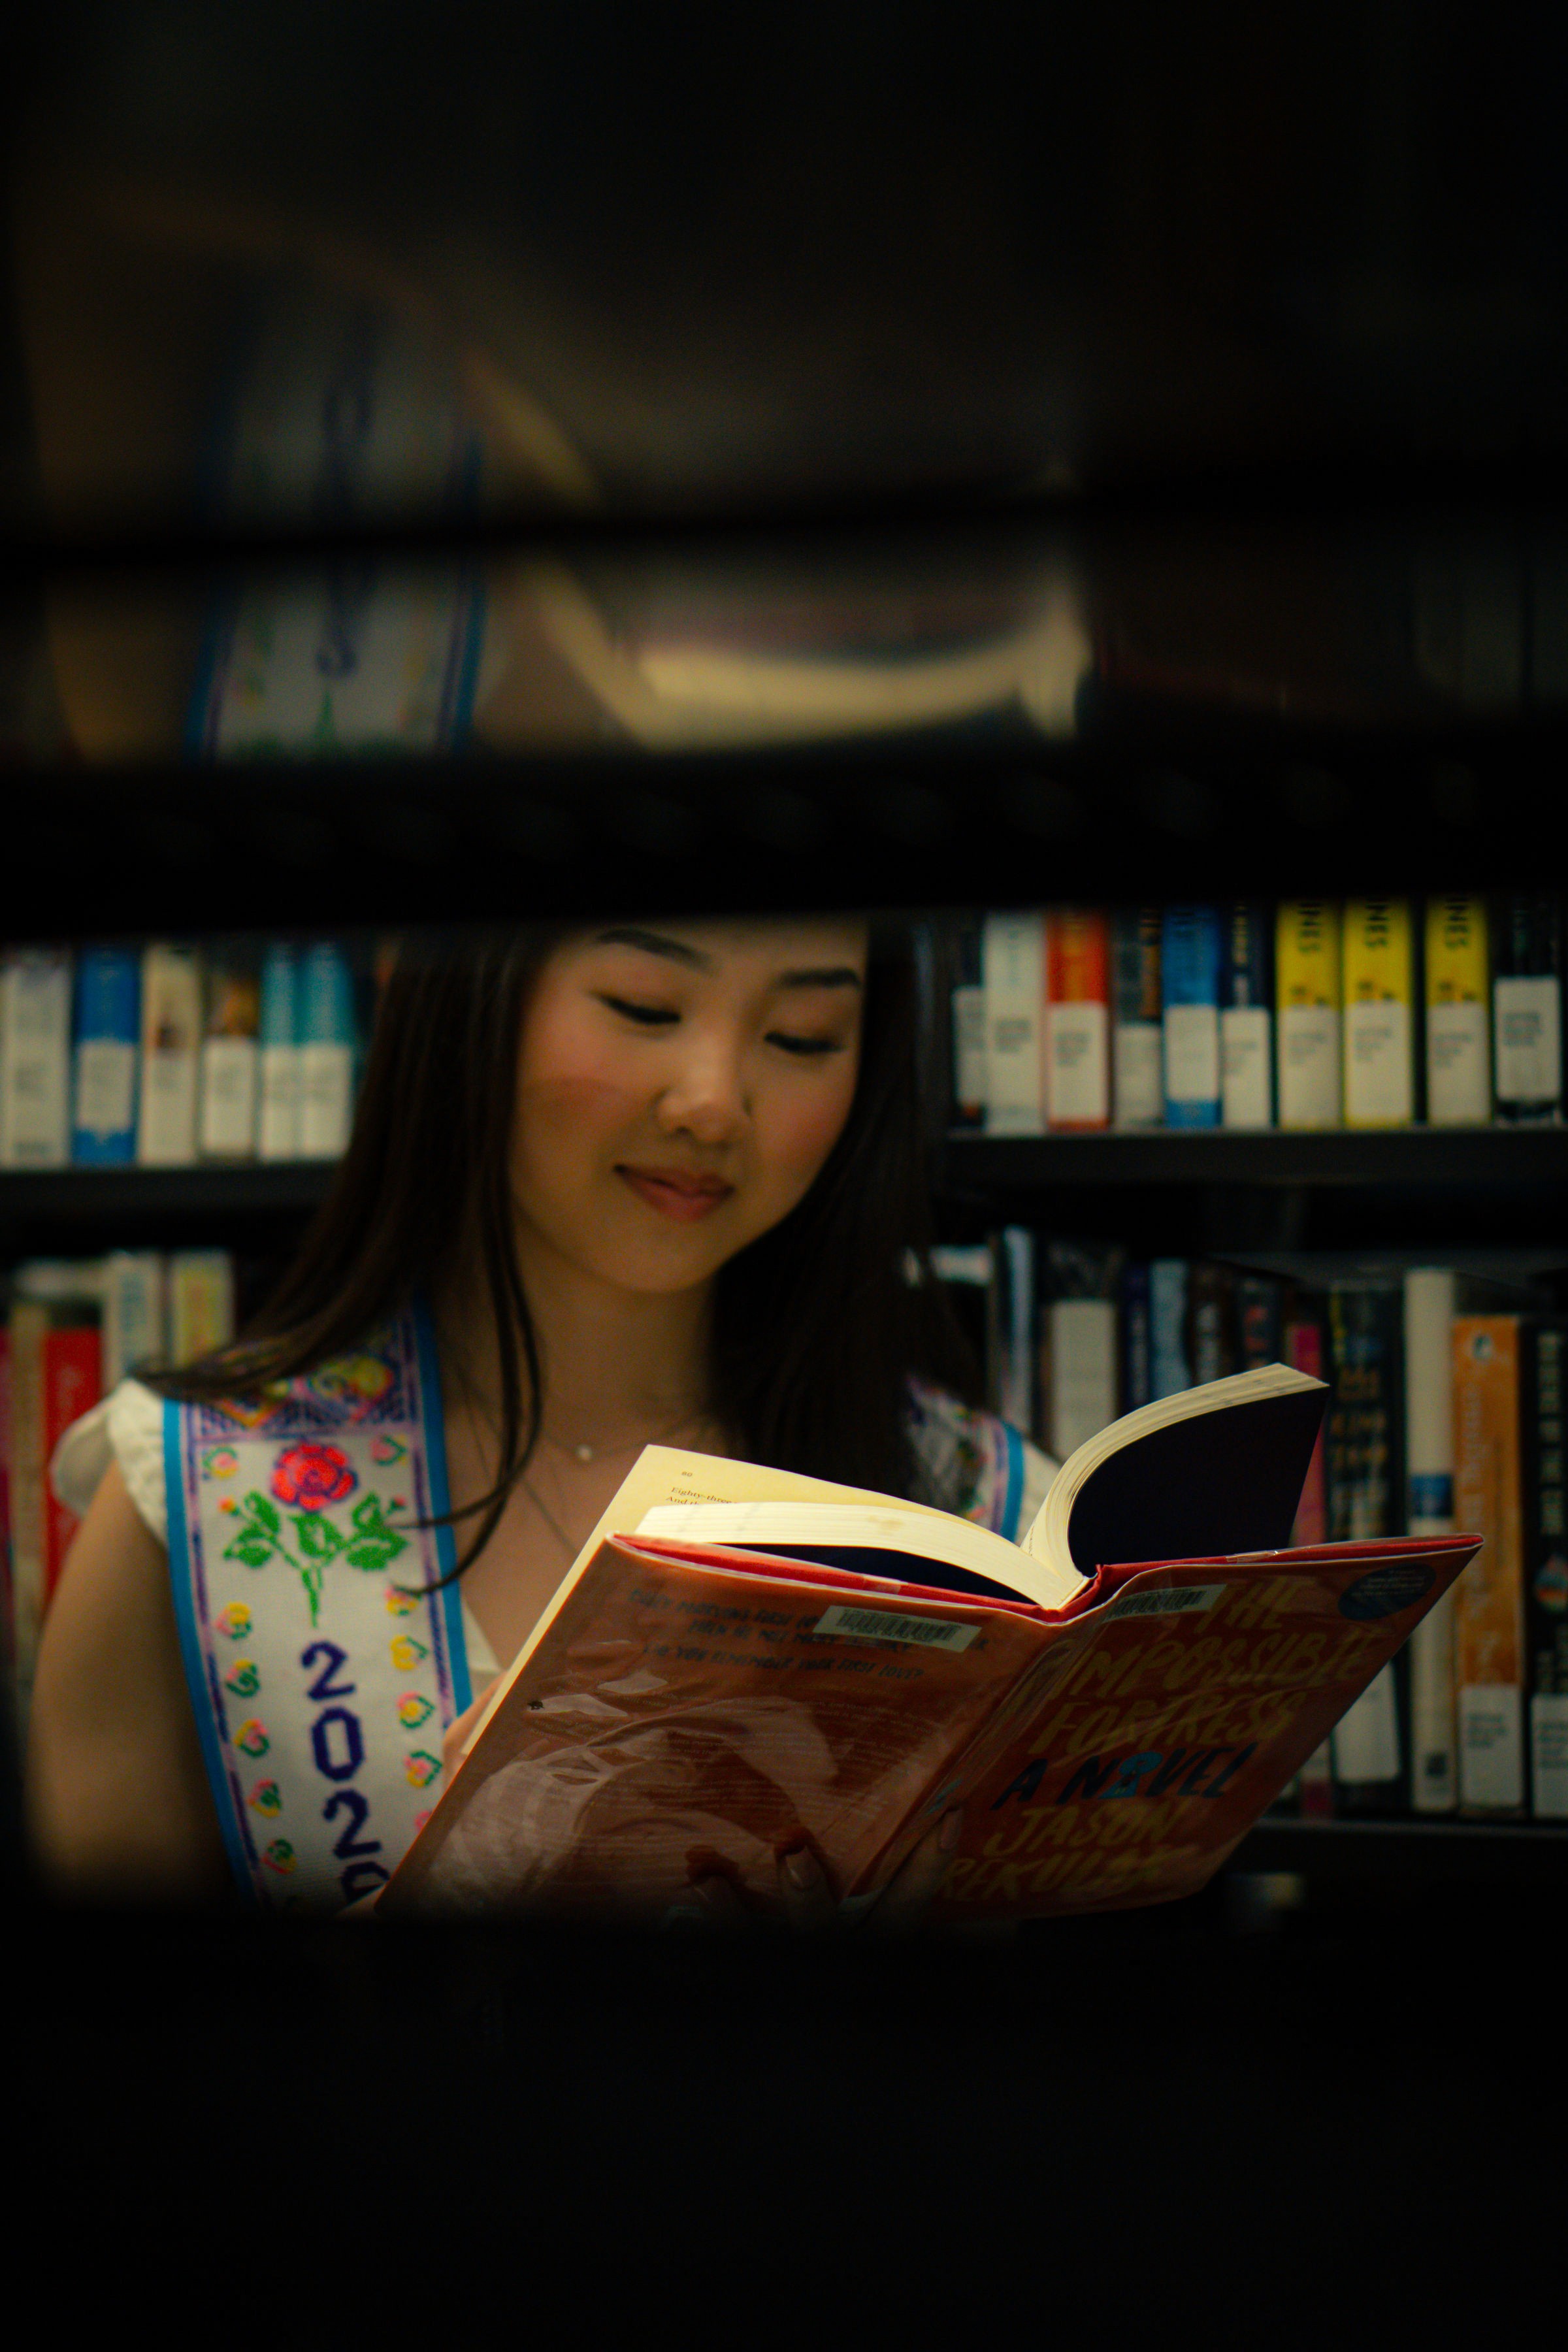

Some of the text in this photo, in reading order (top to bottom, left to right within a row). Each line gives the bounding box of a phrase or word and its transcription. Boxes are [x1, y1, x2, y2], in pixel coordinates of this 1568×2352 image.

[1194, 1576, 1312, 1633] THE
[1028, 1691, 1306, 1756] FORTRESS
[990, 1742, 1258, 1810] A NOVEL
[983, 1799, 1190, 1857] JASON
